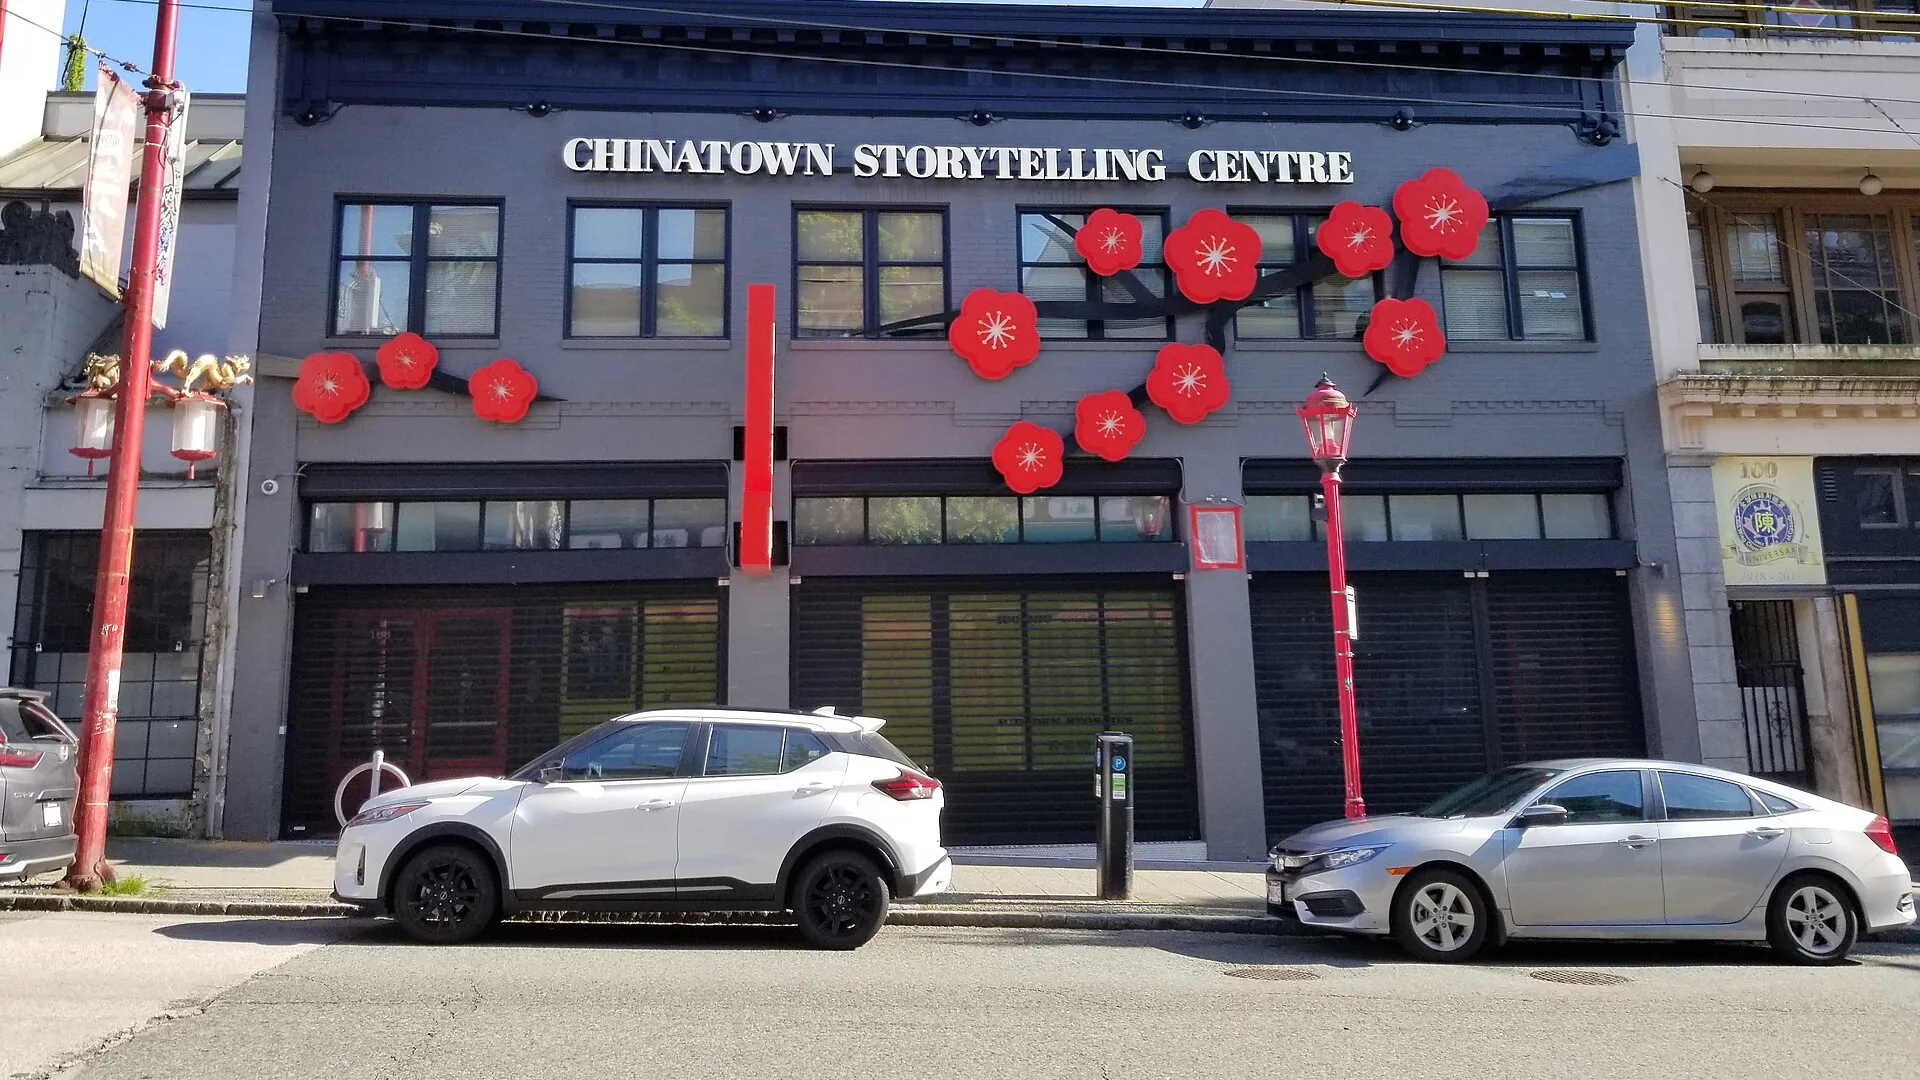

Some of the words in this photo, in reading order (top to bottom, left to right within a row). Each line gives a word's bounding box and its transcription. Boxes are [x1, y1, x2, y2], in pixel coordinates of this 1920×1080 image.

[563, 138, 834, 176] CHINATOWN
[854, 144, 1167, 182] STORYTELLING
[1188, 150, 1354, 184] CENTRE
[1740, 461, 1778, 479] 100
[1754, 511, 1777, 533] 陳
